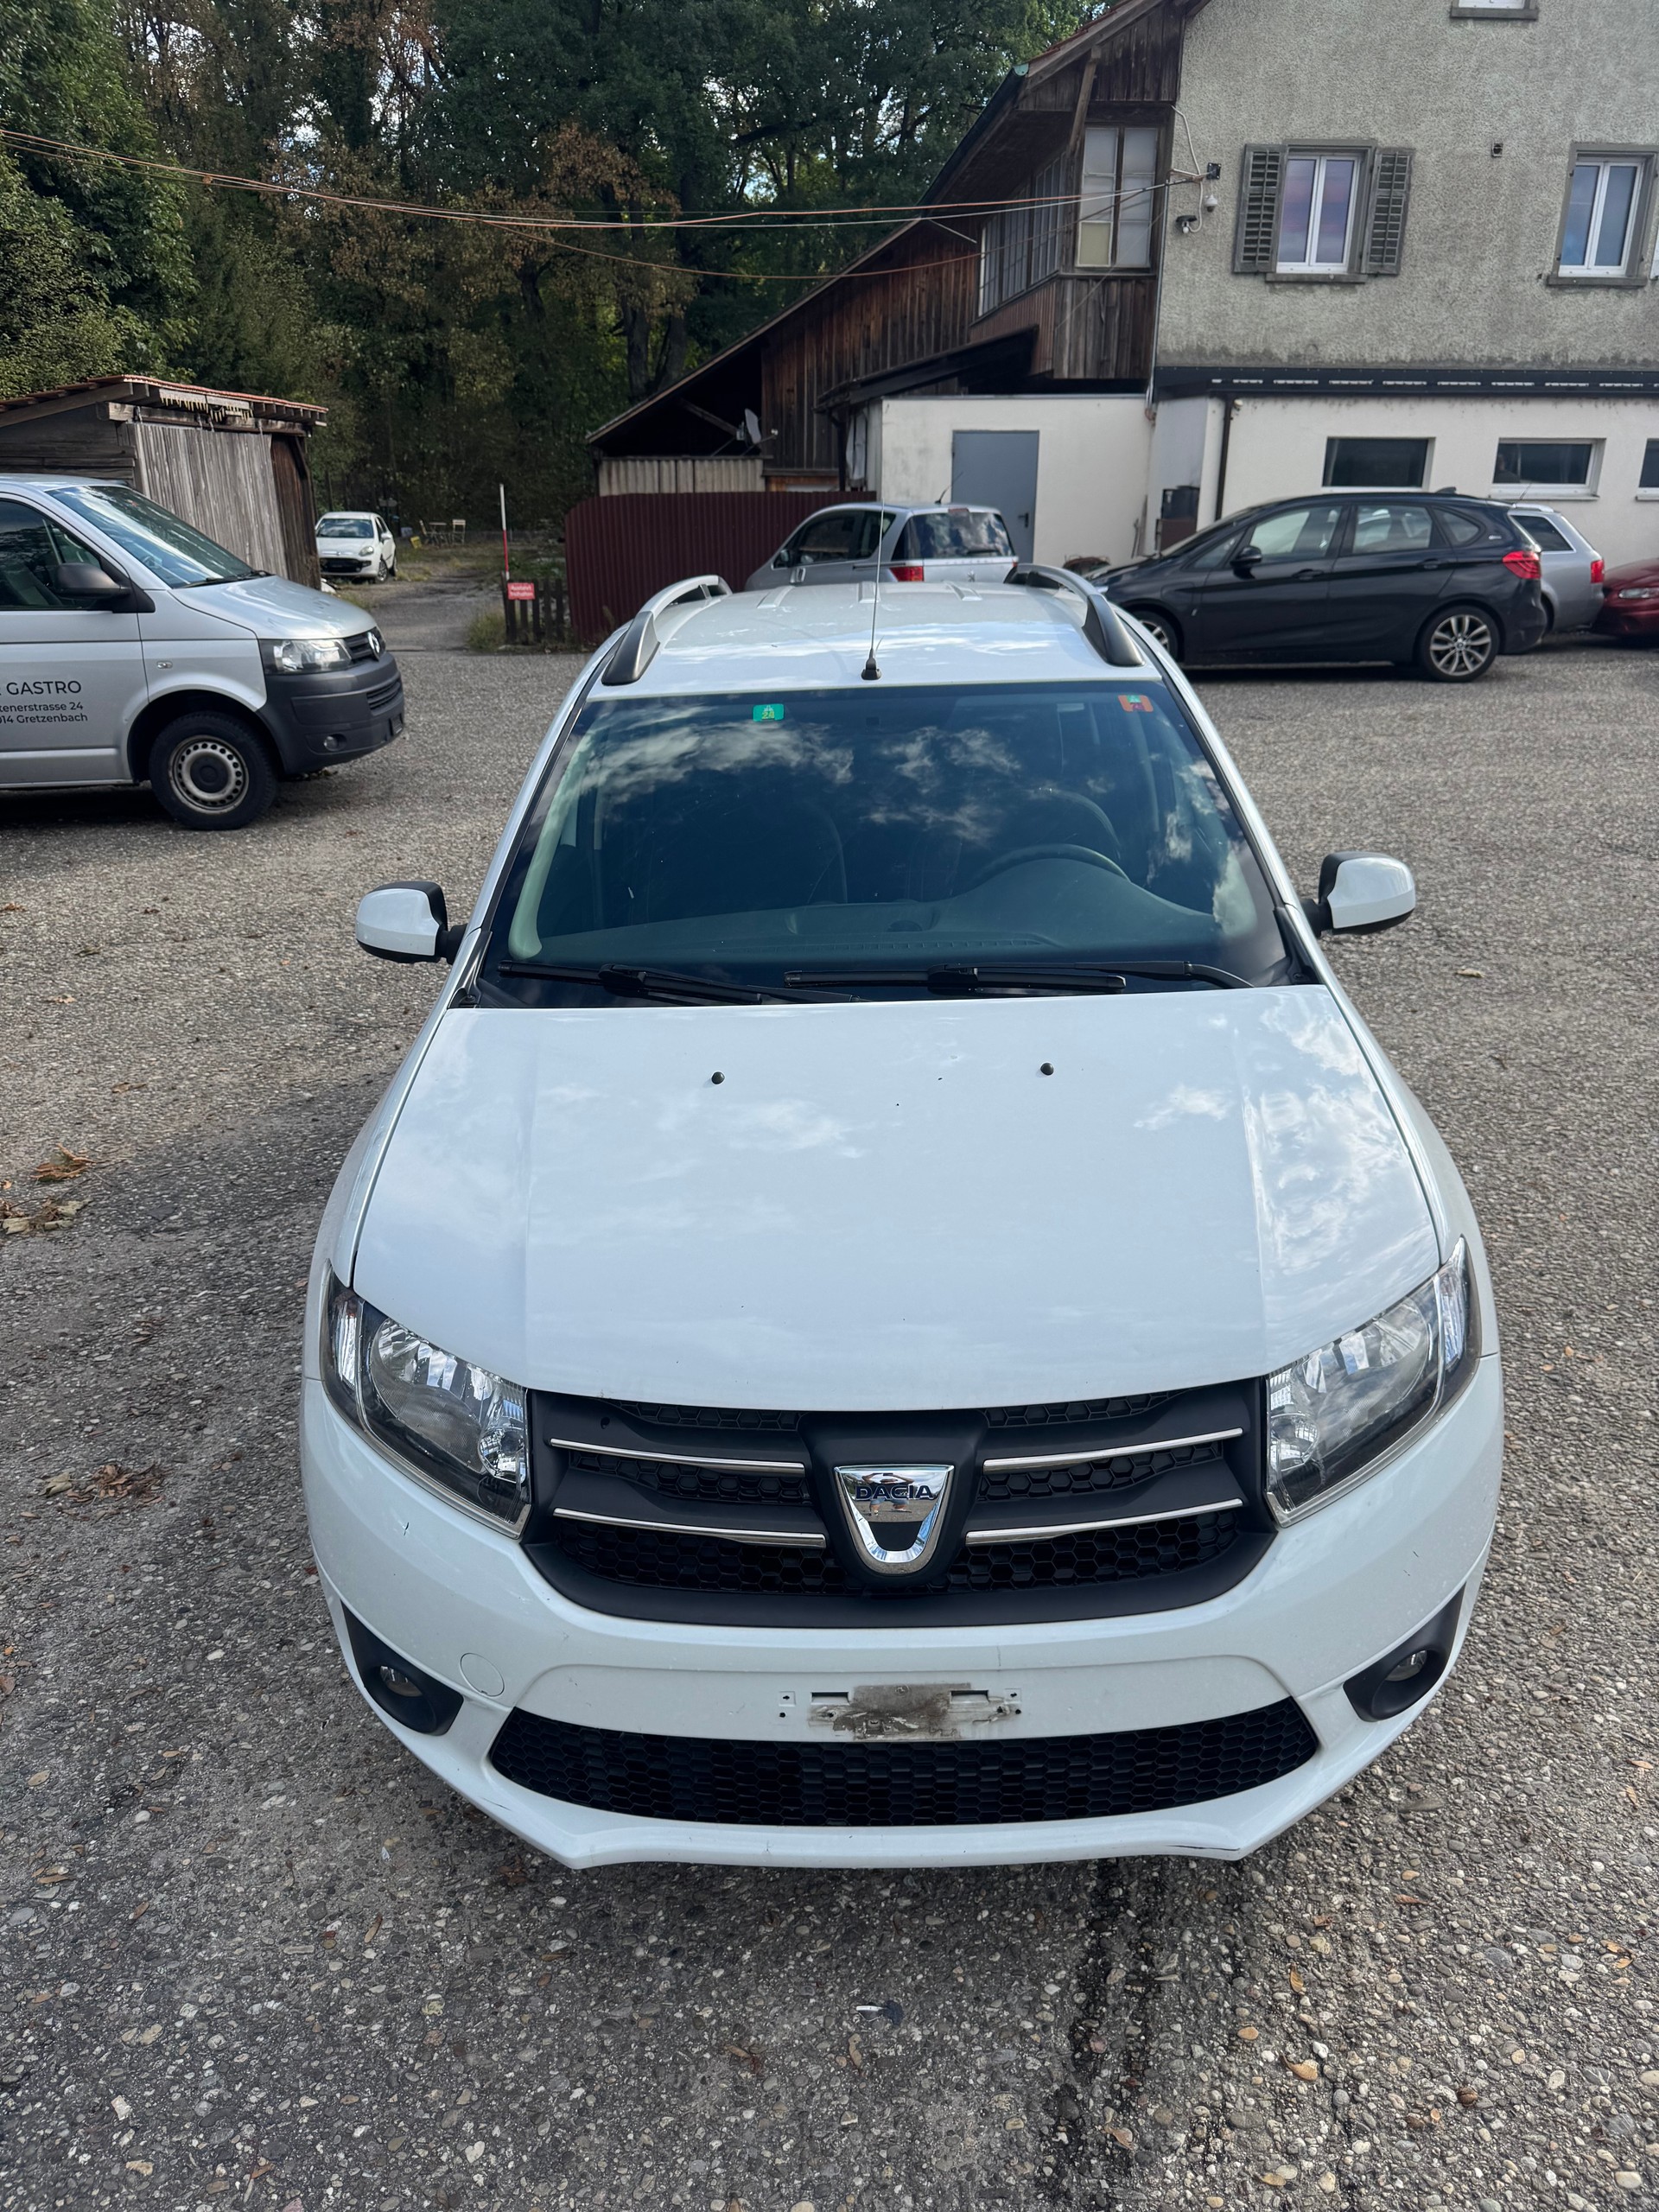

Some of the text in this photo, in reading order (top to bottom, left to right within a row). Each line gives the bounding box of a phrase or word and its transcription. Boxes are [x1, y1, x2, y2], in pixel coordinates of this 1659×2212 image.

[6, 680, 82, 696] GASTRO
[69, 702, 84, 710] 24
[16, 713, 88, 724] Gretzenbach
[855, 1485, 933, 1500] DACIA
